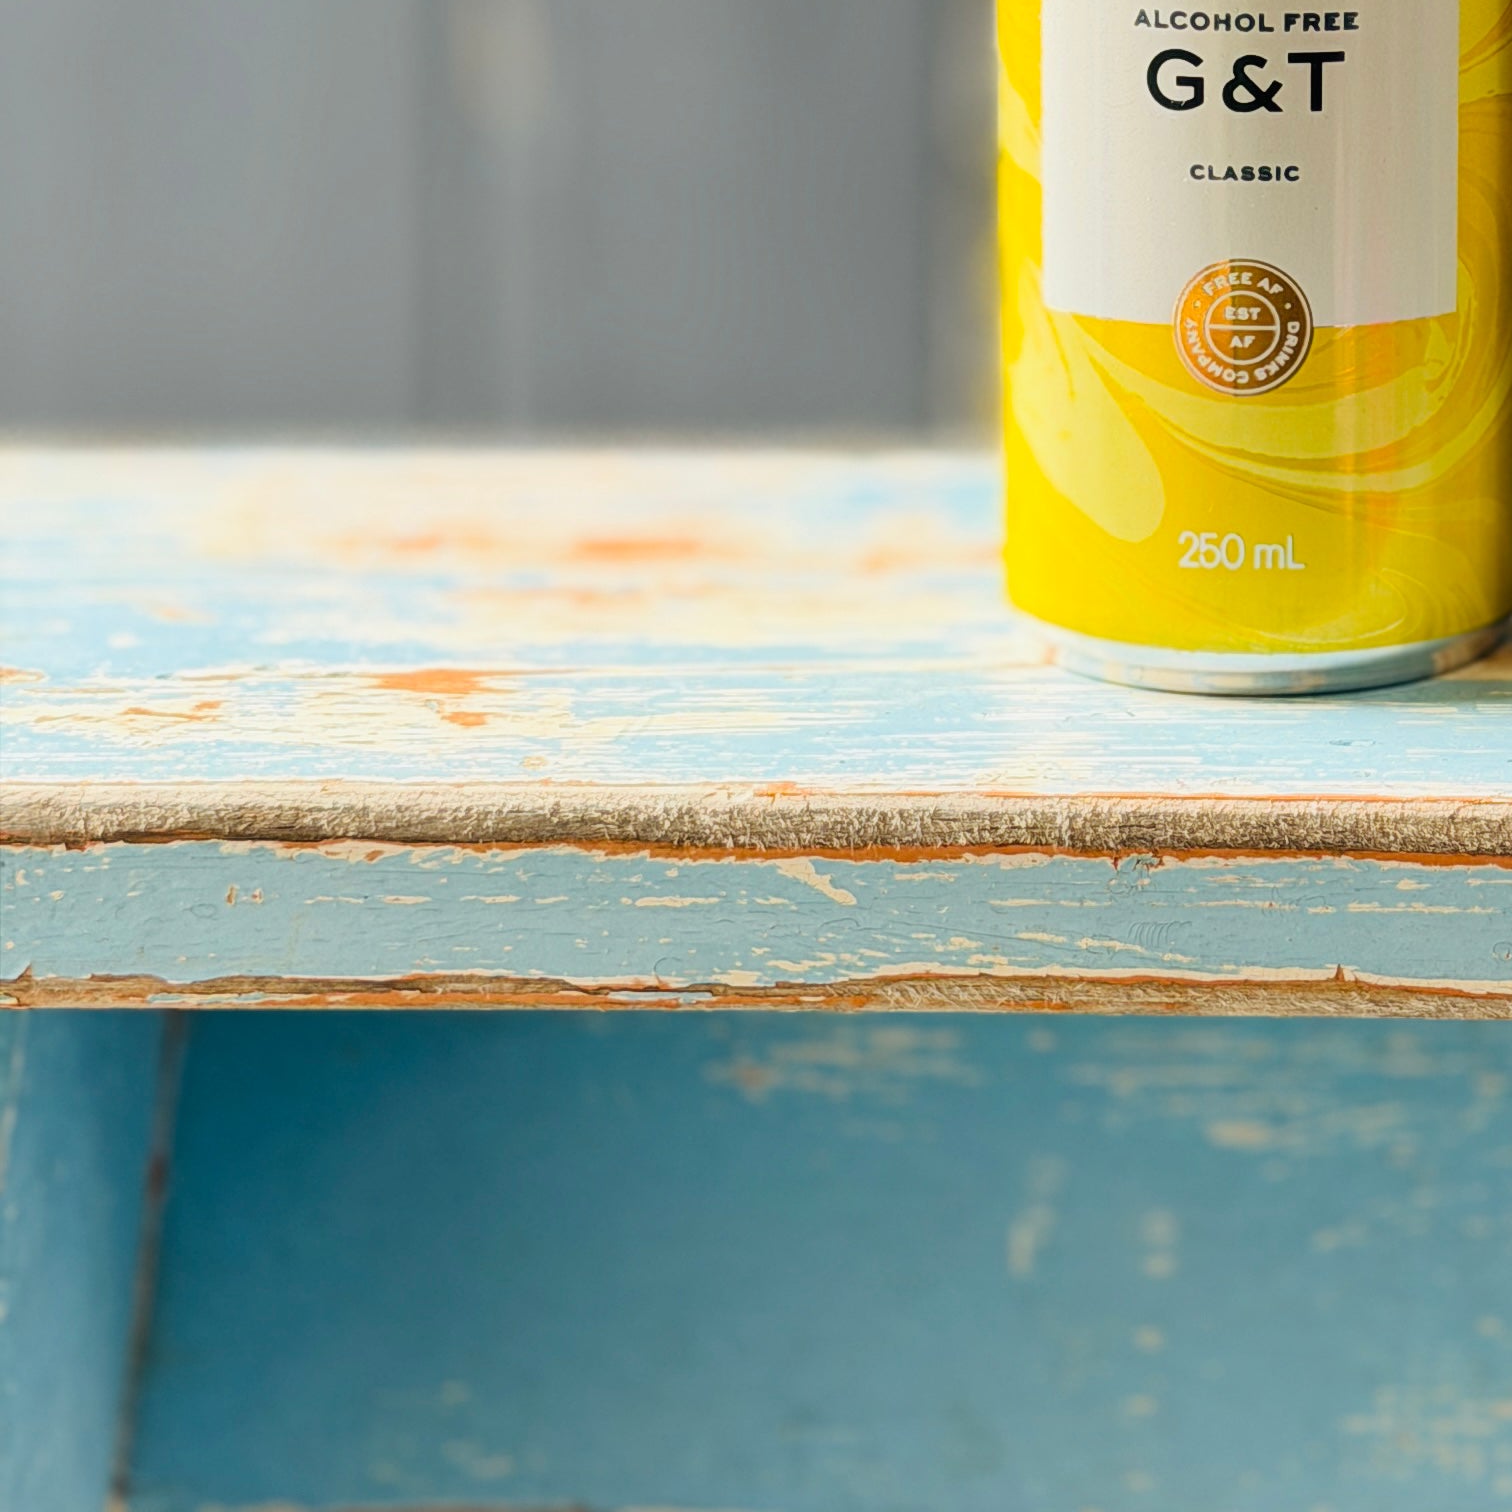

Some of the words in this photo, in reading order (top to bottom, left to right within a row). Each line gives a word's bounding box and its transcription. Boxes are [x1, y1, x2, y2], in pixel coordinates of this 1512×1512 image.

[1133, 8, 1275, 32] ALCOHOL
[1283, 11, 1361, 32] FREE
[1145, 47, 1347, 114] G&T
[1188, 163, 1301, 182] CLASSIC
[1202, 272, 1254, 297] FREE
[1256, 277, 1284, 295] AF
[1223, 306, 1262, 321] EST
[1184, 317, 1250, 384] COMPANY
[1229, 335, 1256, 349] AF
[1253, 320, 1301, 381] DRINKS
[1177, 529, 1246, 571] 250
[1252, 534, 1306, 570] mL
